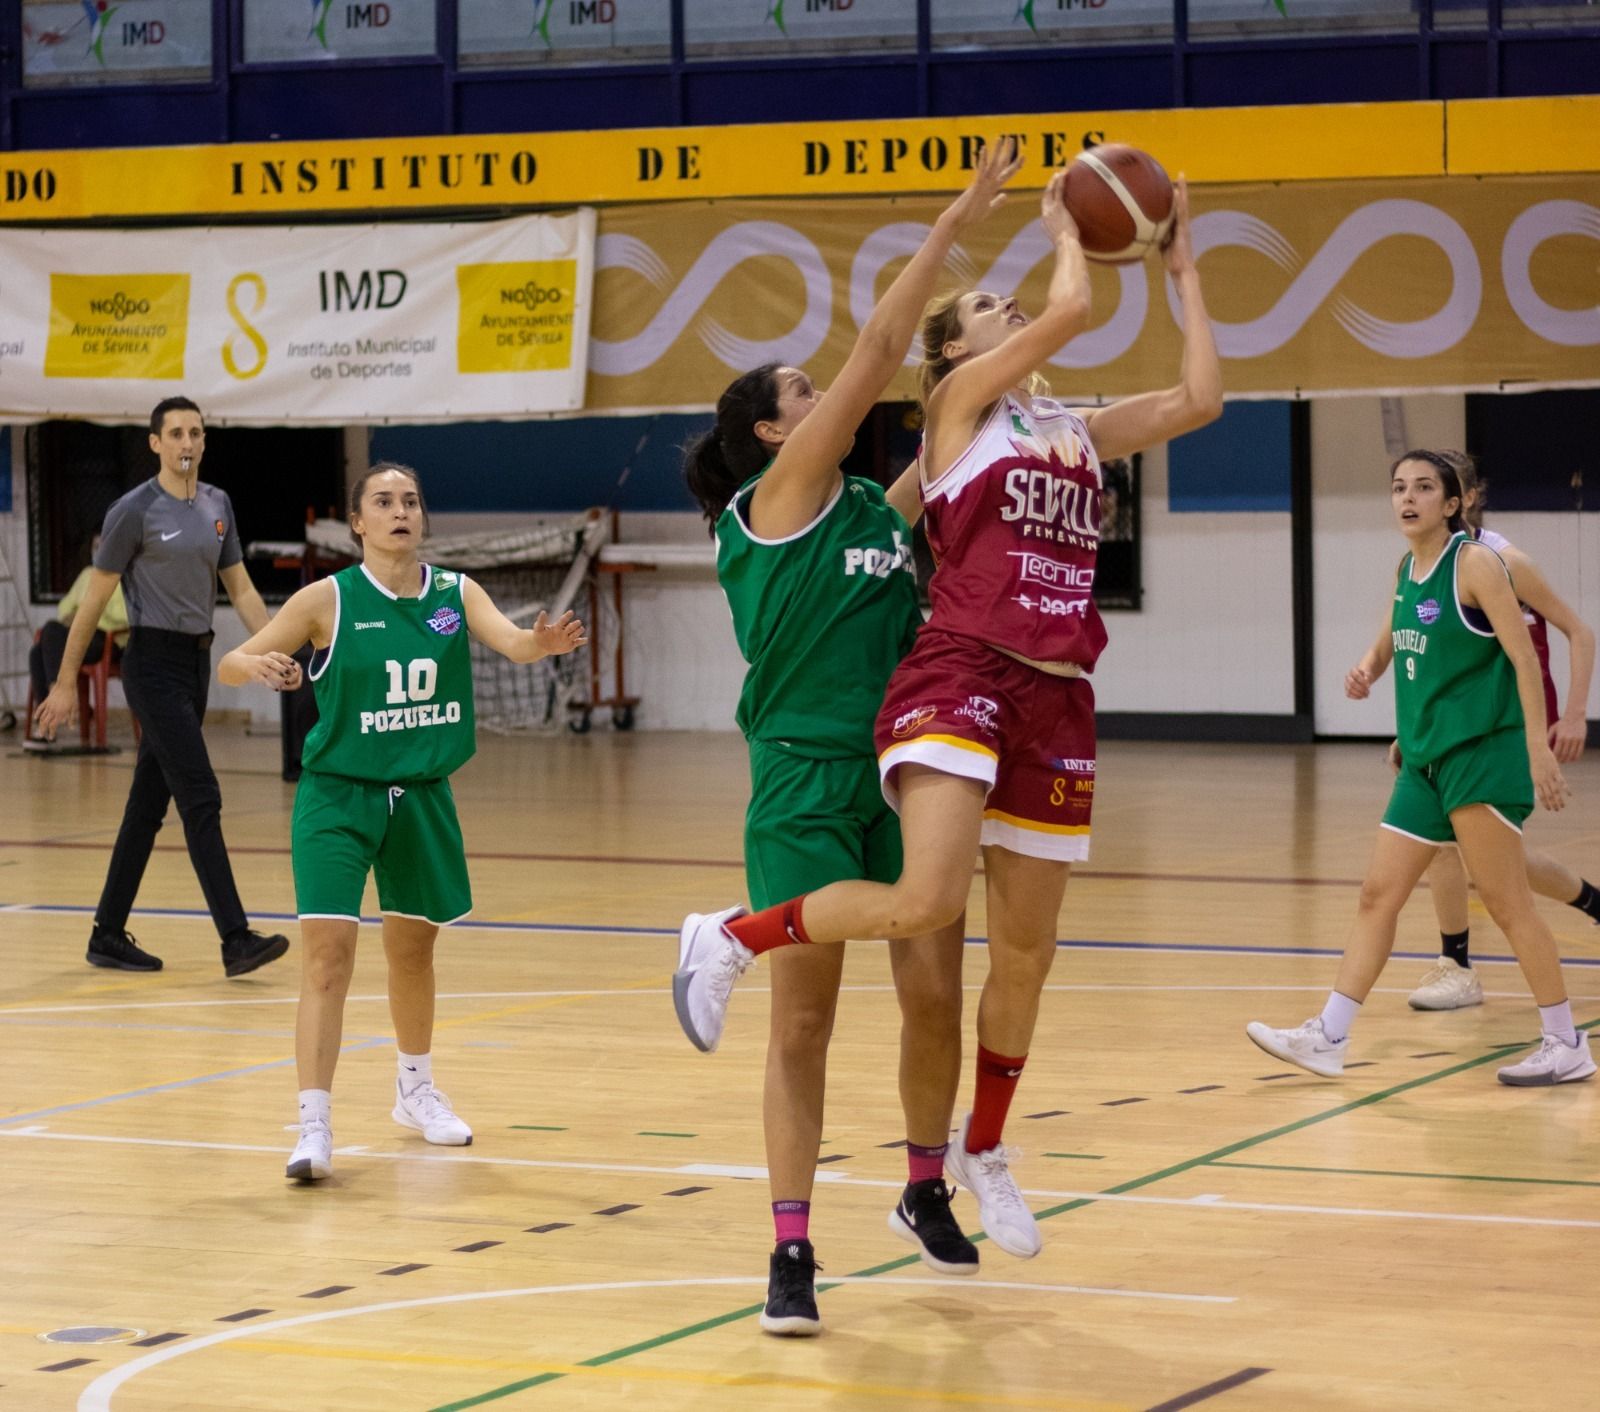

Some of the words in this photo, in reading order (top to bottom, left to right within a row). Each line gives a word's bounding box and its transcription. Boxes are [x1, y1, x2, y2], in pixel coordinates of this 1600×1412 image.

[345, 2, 391, 29] IMD
[569, 0, 616, 25] IMD
[122, 21, 165, 46] IMD
[231, 151, 538, 195] INSTITUTO
[637, 146, 701, 182] DE
[319, 269, 408, 312] IMD
[287, 341, 350, 358] Instituto
[355, 336, 437, 356] Municipal
[310, 363, 332, 381] de
[337, 360, 412, 382] Deportes
[999, 468, 1102, 537] SEVILL
[354, 620, 386, 631] SPALDING
[1392, 628, 1427, 655] POZUELO
[385, 658, 438, 705] 10
[1406, 656, 1415, 681] 9
[360, 701, 461, 734] POZUELO
